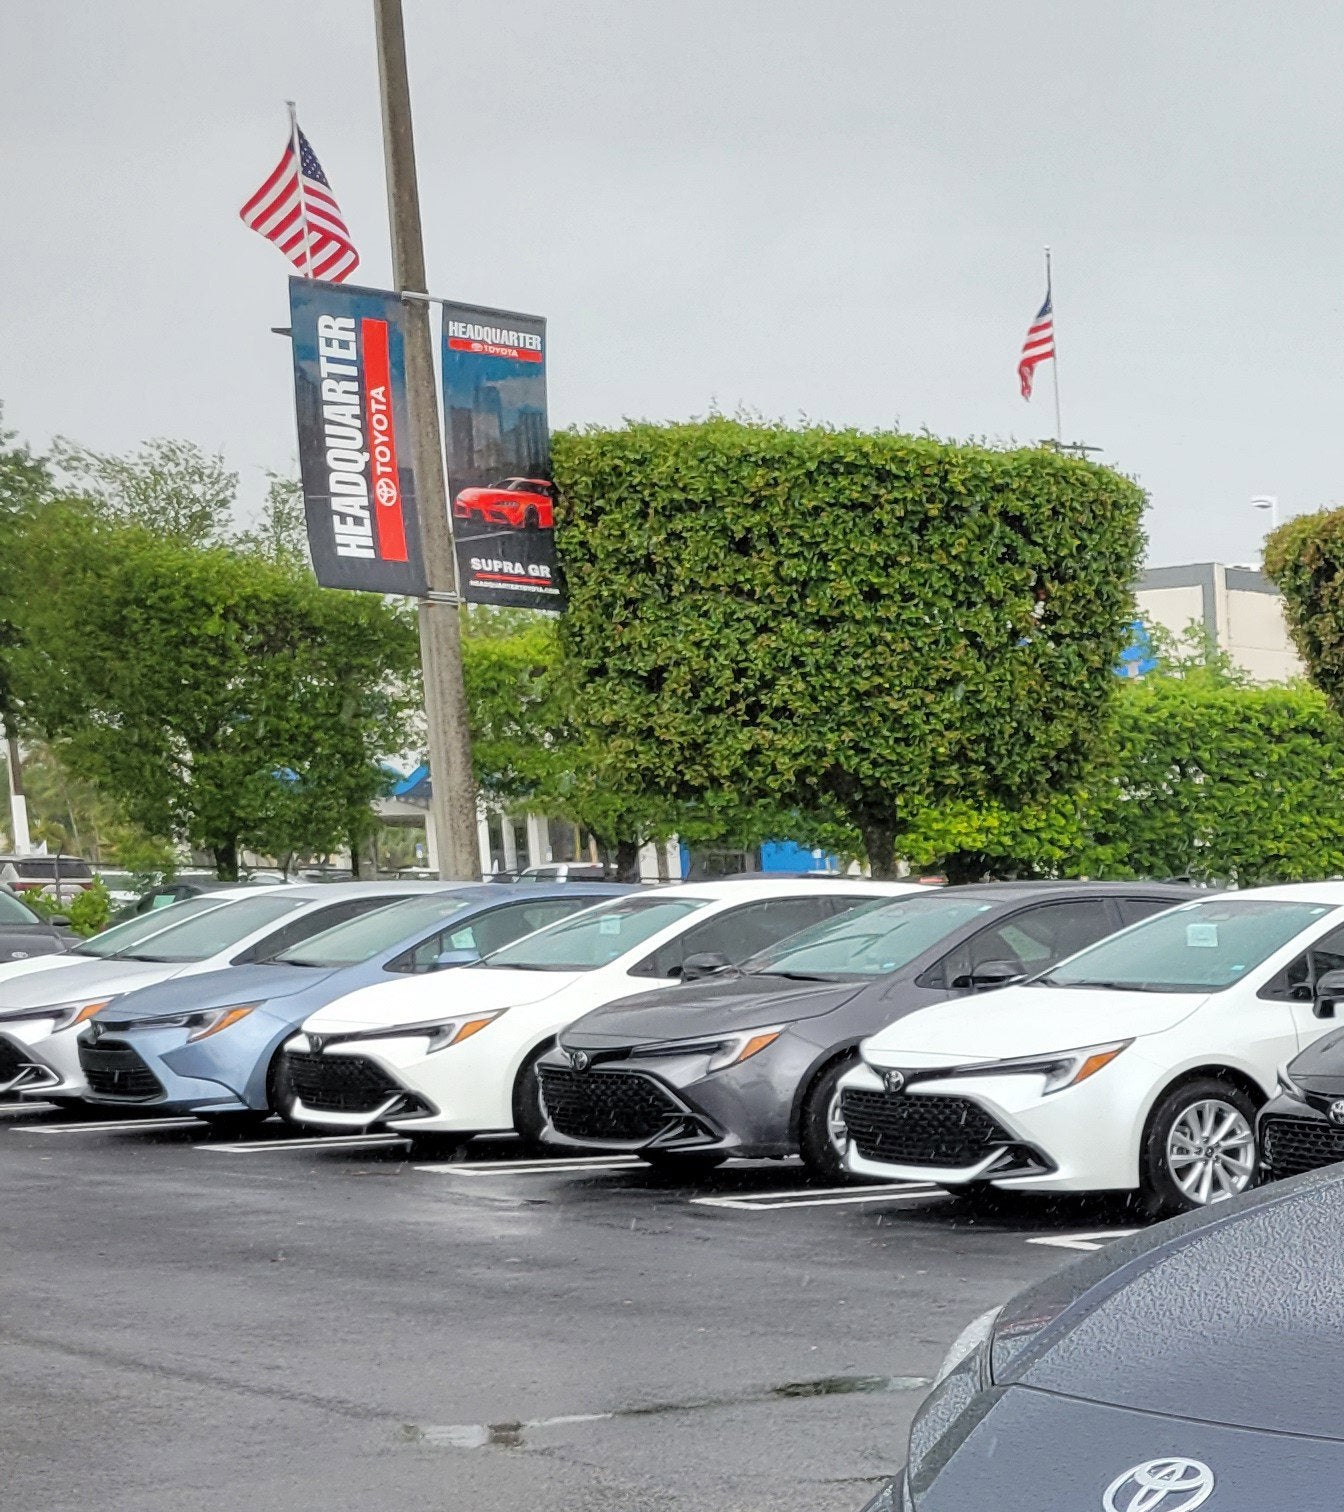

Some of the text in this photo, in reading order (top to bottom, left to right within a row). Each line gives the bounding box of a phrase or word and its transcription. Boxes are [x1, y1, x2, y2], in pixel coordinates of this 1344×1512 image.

[448, 320, 542, 351] HEADQUARTER
[483, 344, 519, 358] TOYOTA
[318, 315, 376, 559] HEADQUARTER
[370, 385, 393, 476] TOYOTA
[470, 557, 552, 579] SUPRA GR
